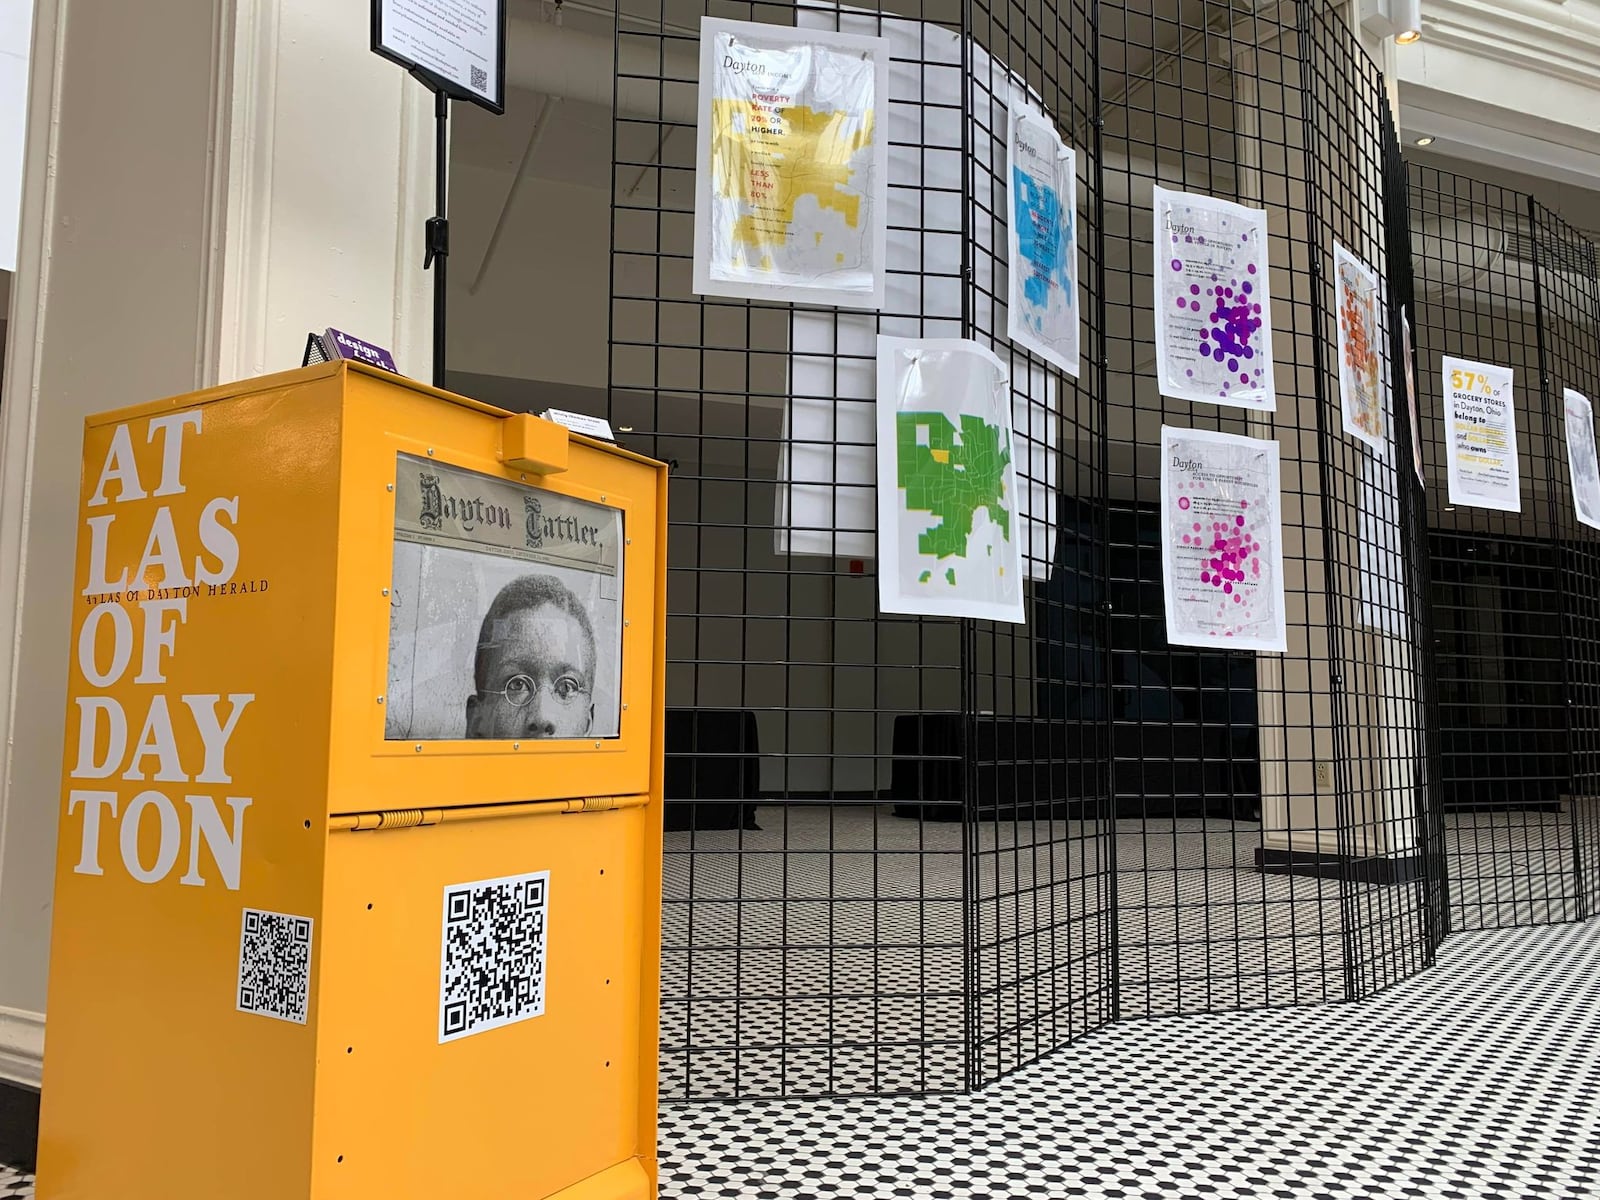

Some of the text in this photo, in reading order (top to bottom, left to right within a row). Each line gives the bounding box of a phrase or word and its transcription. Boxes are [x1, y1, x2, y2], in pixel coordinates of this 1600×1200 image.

[723, 55, 766, 75] Dayton
[752, 93, 790, 103] POVERTY
[752, 104, 773, 112] RATE
[751, 115, 768, 123] 20%
[750, 169, 769, 178] LESS
[751, 180, 774, 189] THAN
[750, 191, 768, 199] 80%
[1165, 220, 1195, 235] Dayton
[337, 333, 379, 358] design
[1452, 369, 1491, 395] 57%
[1453, 392, 1506, 407] GROCERY STORES
[1455, 411, 1477, 424] belong
[1486, 406, 1501, 416] Ohio
[1457, 442, 1469, 451] who
[87, 409, 202, 506] AT
[1172, 456, 1203, 472] Dayton
[419, 472, 513, 531] Dayton
[82, 495, 239, 597] LAS
[148, 586, 200, 600] DAYTON
[208, 580, 268, 596] HERALD
[78, 599, 188, 688] OF
[70, 692, 255, 784] DAY
[68, 790, 253, 890] TON
